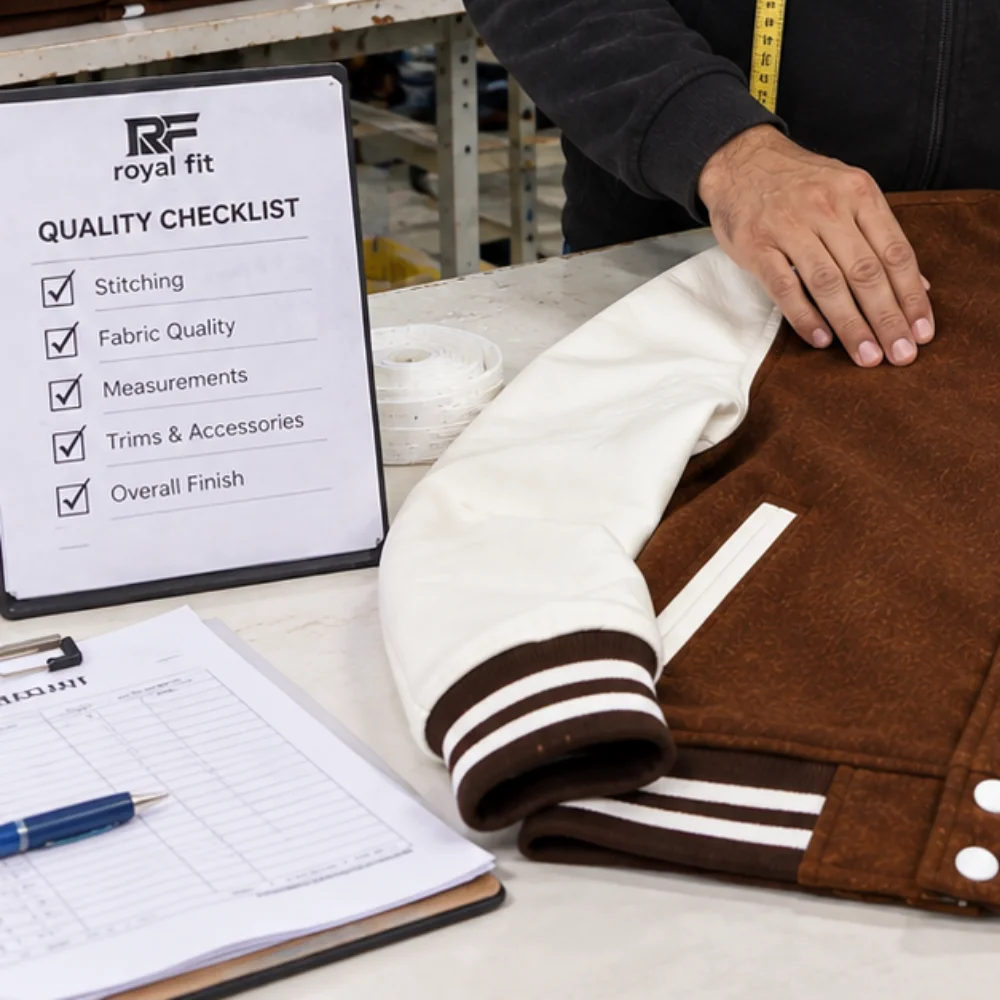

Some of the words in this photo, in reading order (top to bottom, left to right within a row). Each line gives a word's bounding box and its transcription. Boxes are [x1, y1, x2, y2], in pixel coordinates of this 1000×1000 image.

[123, 112, 201, 157] RF
[114, 156, 176, 183] royal
[185, 153, 214, 175] fit
[38, 212, 152, 243] QUALITY
[160, 198, 299, 229] CHECKLIST
[95, 273, 184, 295] Stitching
[99, 326, 160, 346] Fabric
[167, 318, 235, 340] Quality
[104, 369, 248, 398] Measurements
[106, 431, 162, 449] Trims
[169, 426, 182, 443] &
[189, 414, 304, 440] Accessories
[111, 478, 180, 502] Overall
[188, 470, 244, 492] Finish
